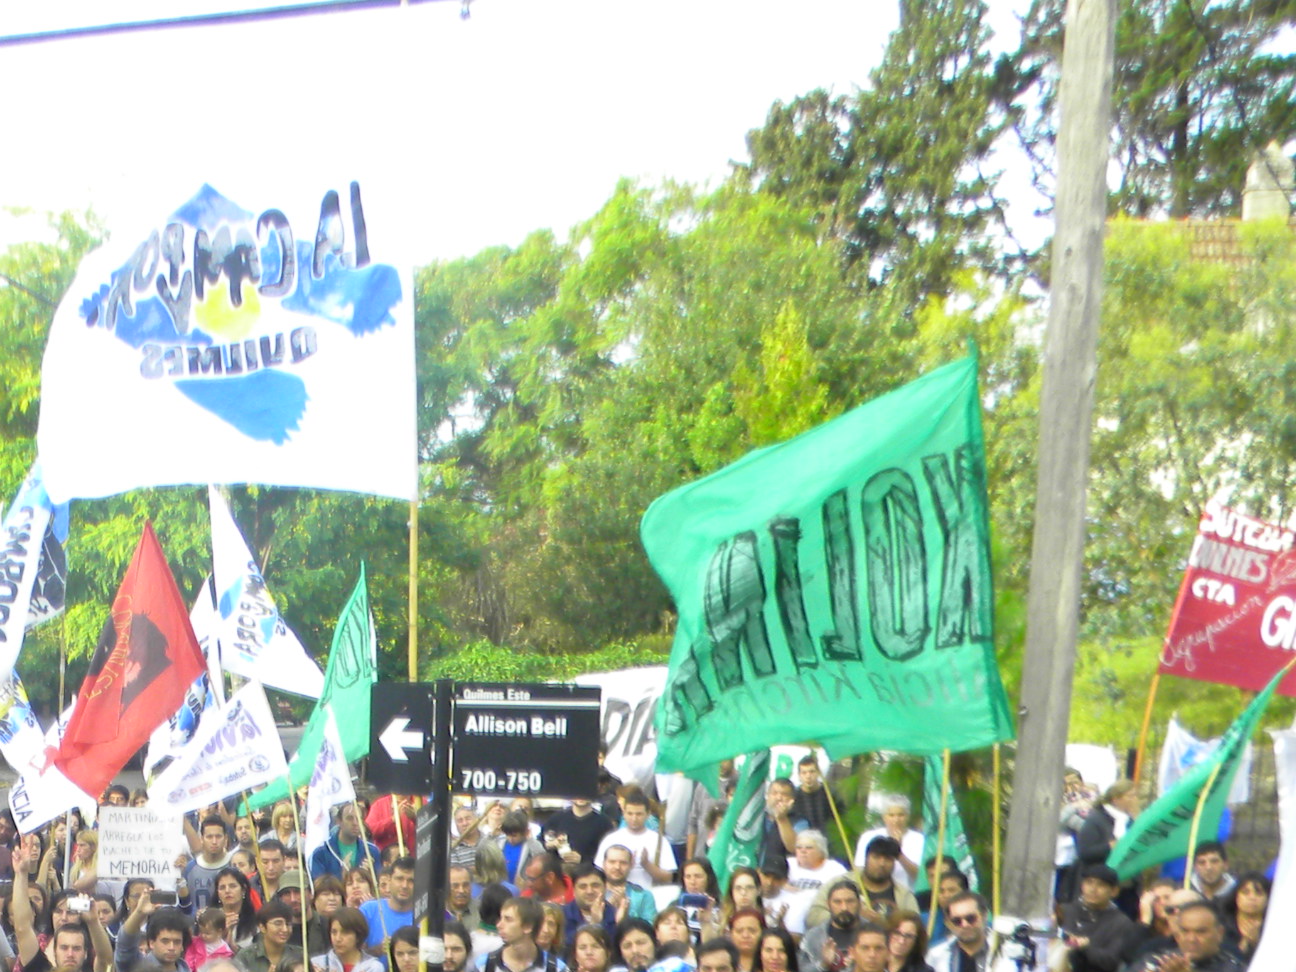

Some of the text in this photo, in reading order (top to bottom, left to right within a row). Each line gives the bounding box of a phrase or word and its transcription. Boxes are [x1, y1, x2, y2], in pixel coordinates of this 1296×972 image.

[1192, 577, 1236, 607] CTA
[463, 688, 531, 701] Quilmes Este
[465, 714, 567, 737] Allison Bell
[461, 770, 542, 791] 700-750
